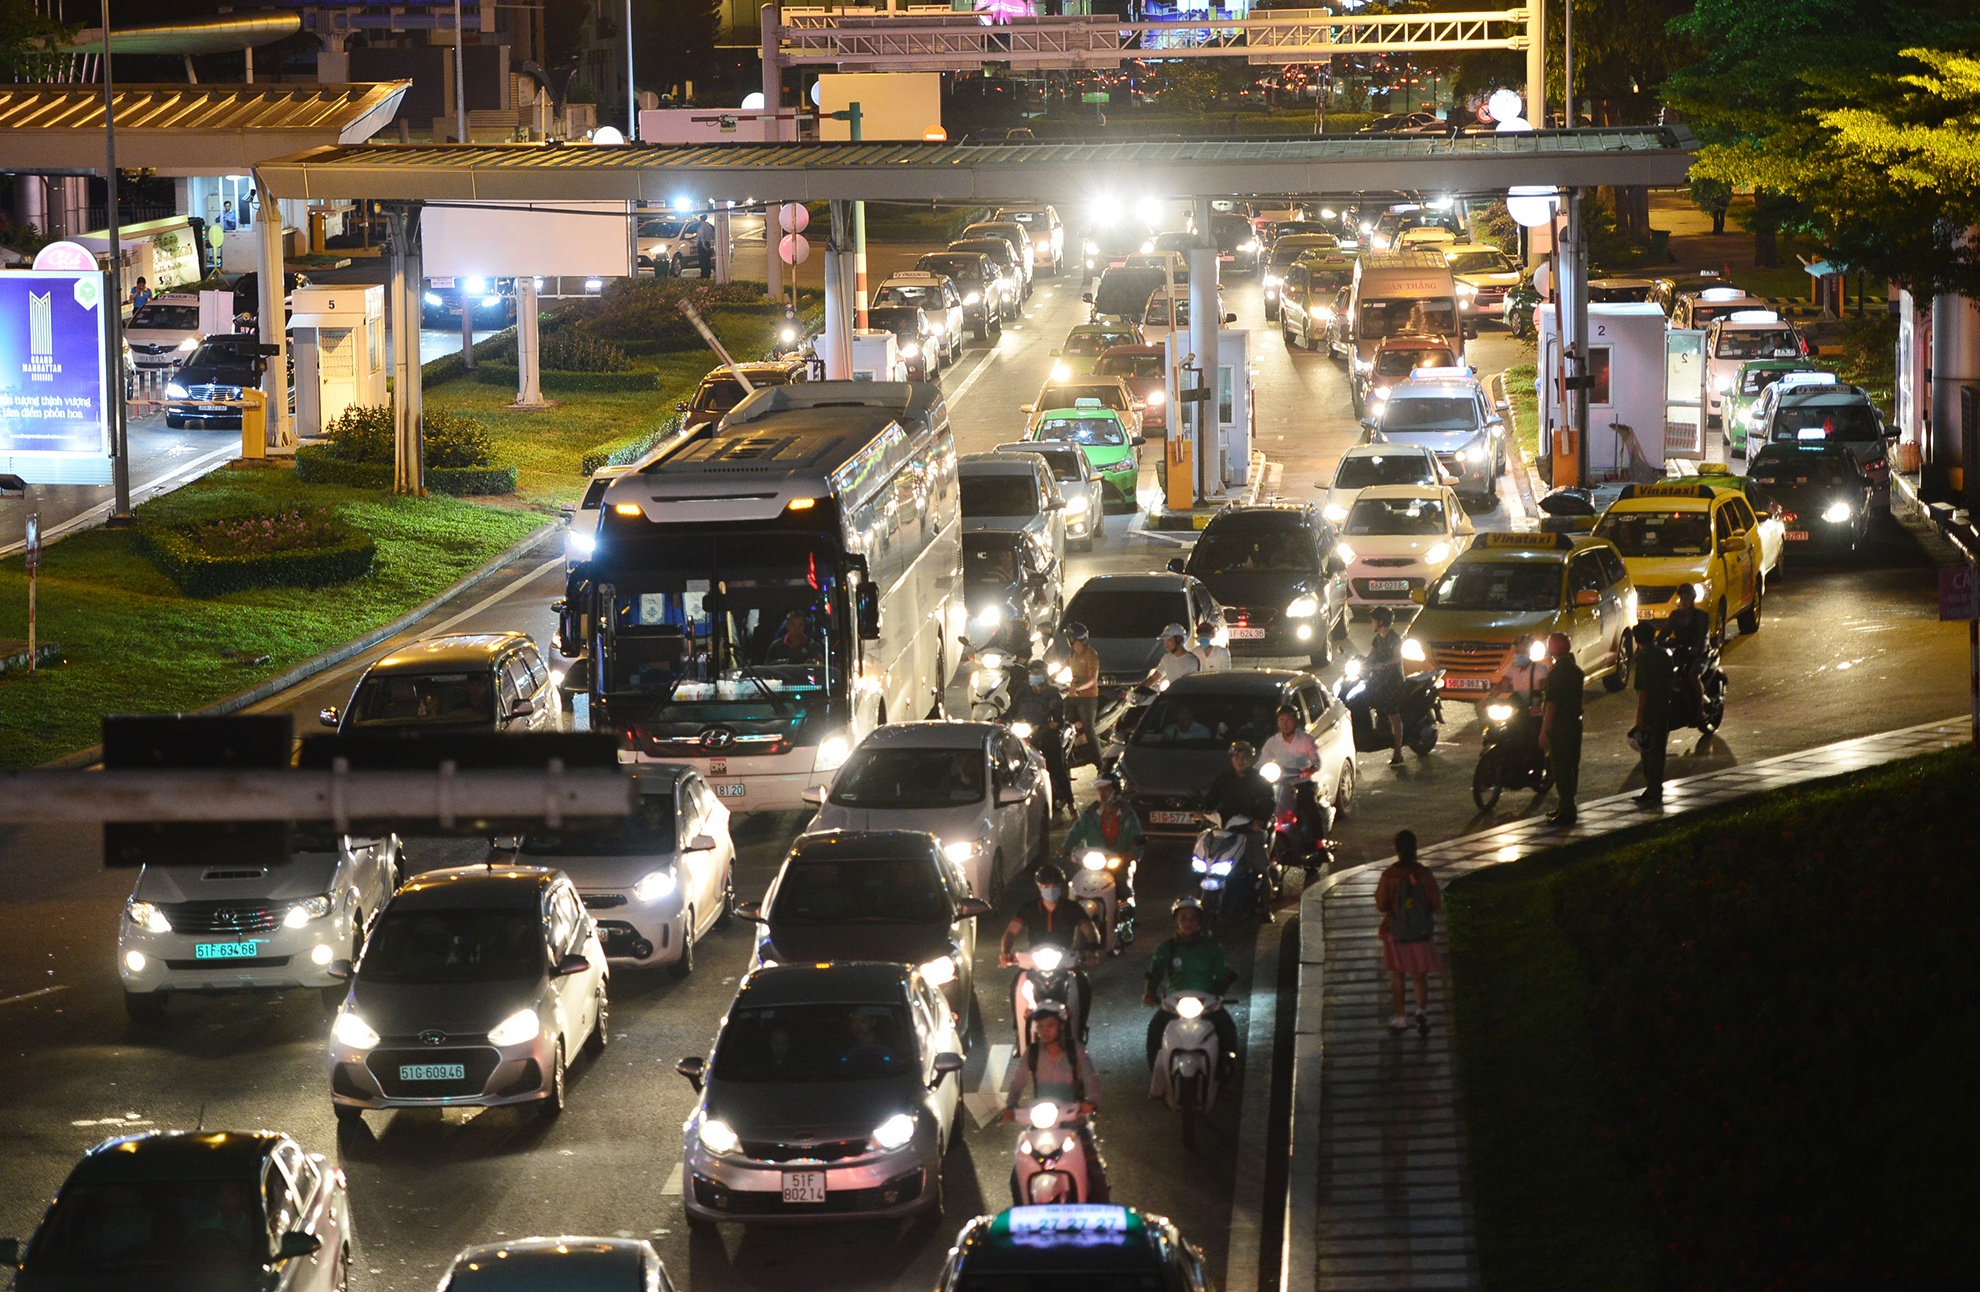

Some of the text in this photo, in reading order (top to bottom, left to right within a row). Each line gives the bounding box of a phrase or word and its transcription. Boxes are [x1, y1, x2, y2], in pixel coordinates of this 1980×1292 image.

[328, 300, 335, 309] 5
[1598, 325, 1606, 336] 2
[30, 355, 53, 364] GRAND
[22, 363, 62, 373] MANHATTAN
[1639, 486, 1695, 496] Vinataxi
[1492, 534, 1550, 544] Vinataxi
[792, 1174, 815, 1188] 51F
